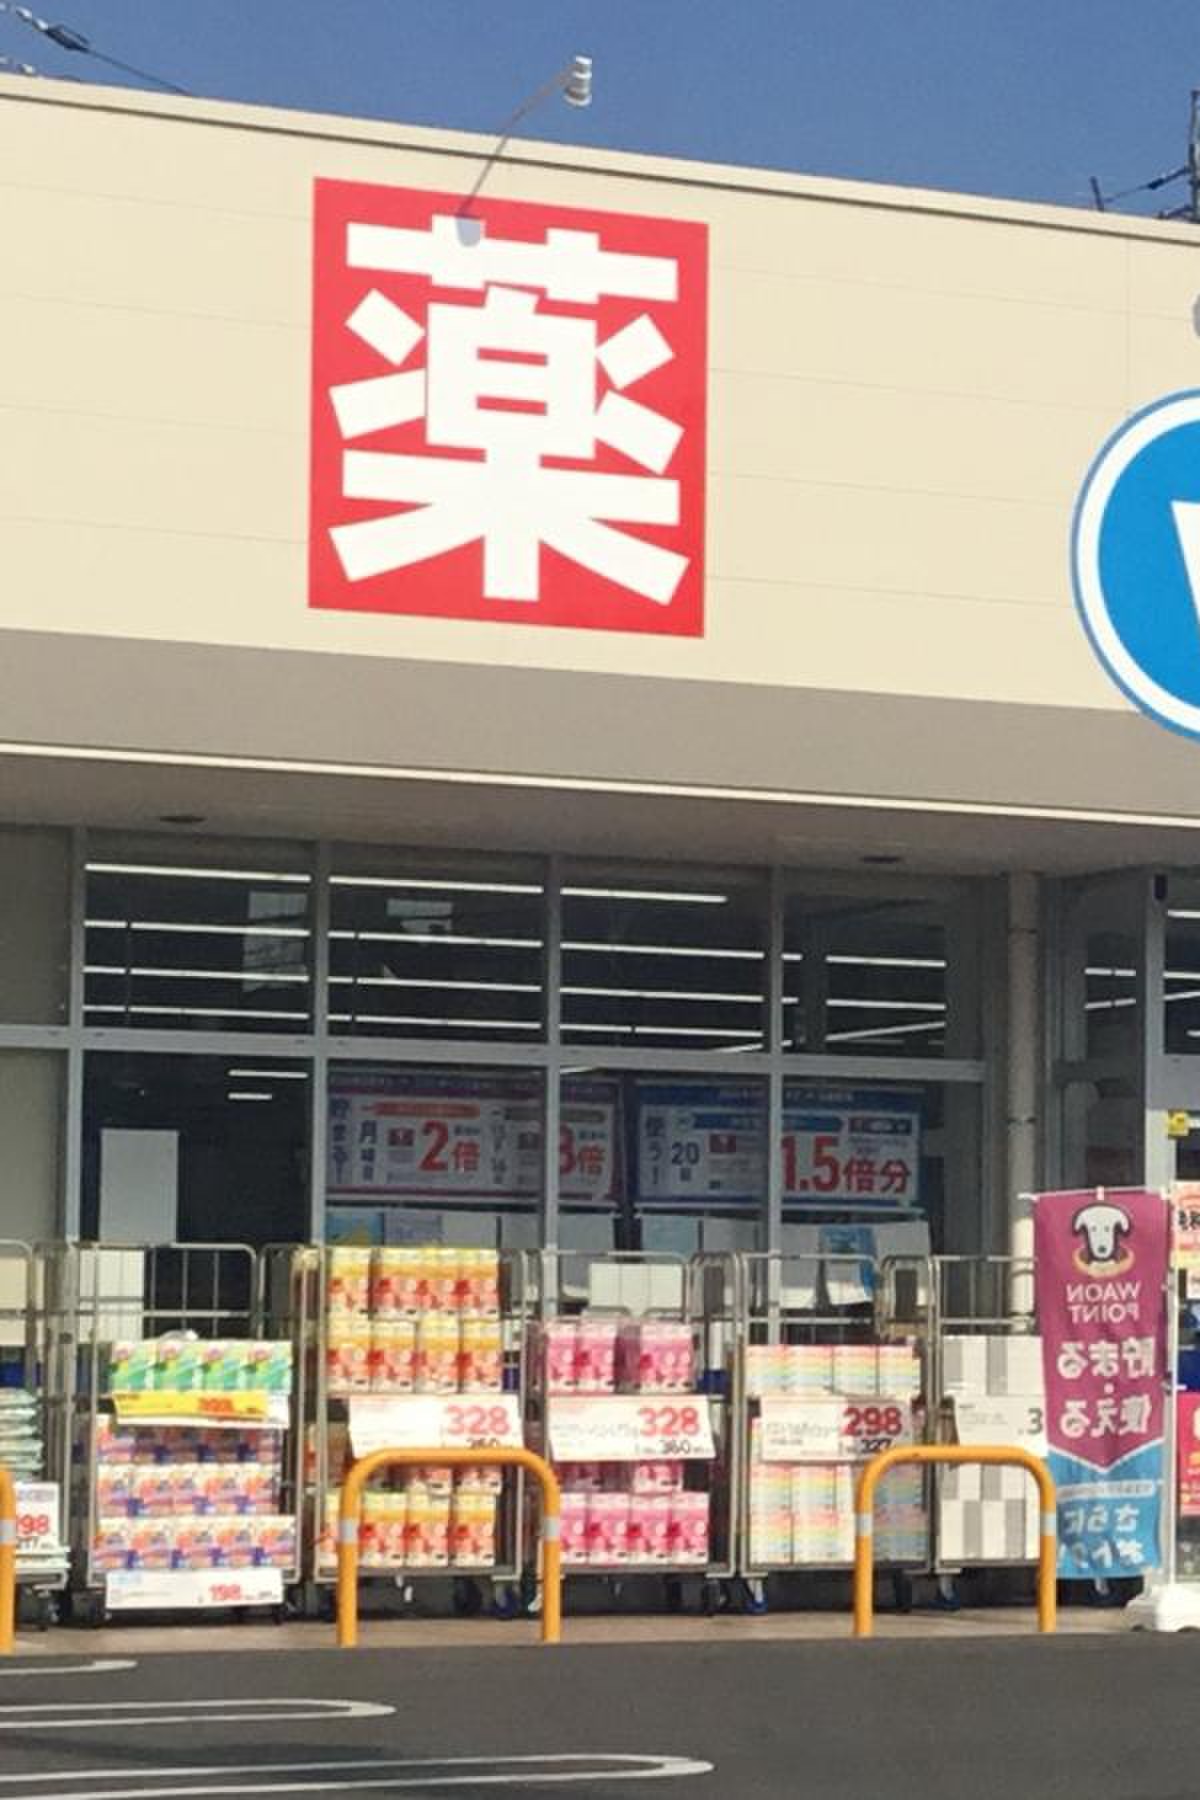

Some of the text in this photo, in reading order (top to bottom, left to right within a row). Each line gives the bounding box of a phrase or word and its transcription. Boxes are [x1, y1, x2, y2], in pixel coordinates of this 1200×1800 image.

[329, 213, 690, 606] 薬
[419, 1120, 481, 1173] 2倍
[781, 1134, 911, 1194] 1.5倍分
[446, 1405, 511, 1435] 328
[638, 1405, 701, 1437] 328
[841, 1406, 903, 1436] 298
